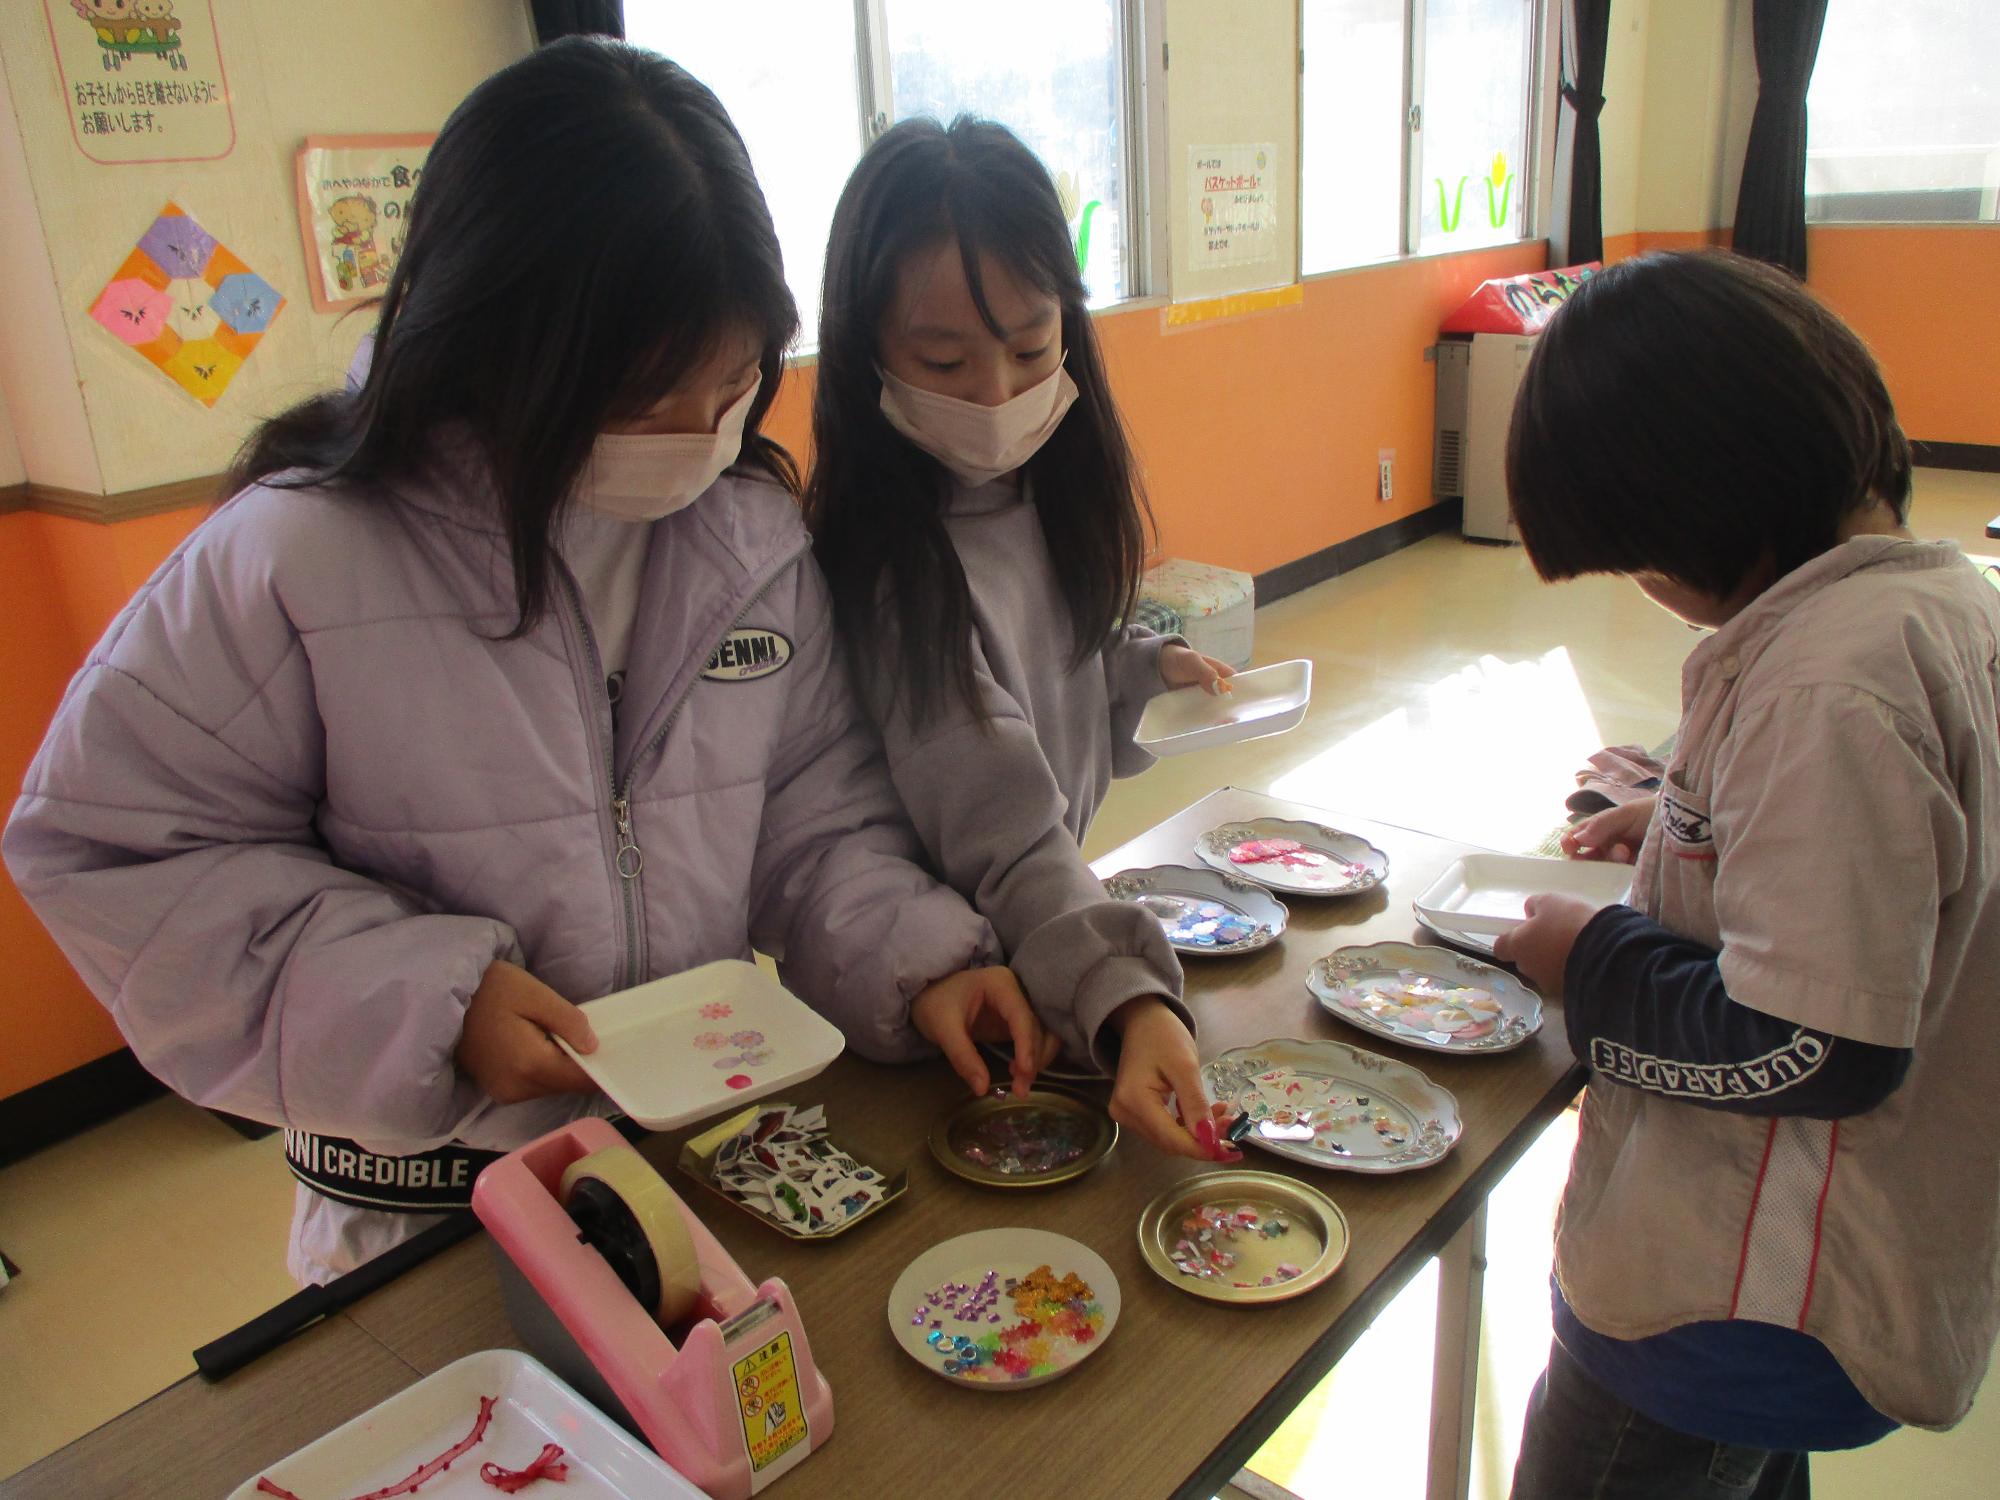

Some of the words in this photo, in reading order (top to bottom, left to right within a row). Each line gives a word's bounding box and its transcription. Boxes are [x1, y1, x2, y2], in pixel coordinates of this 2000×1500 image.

[74, 80, 219, 106] お子さんから目を離さないように
[81, 111, 165, 135] お願いします。
[324, 1144, 470, 1189] CREDIBLE
